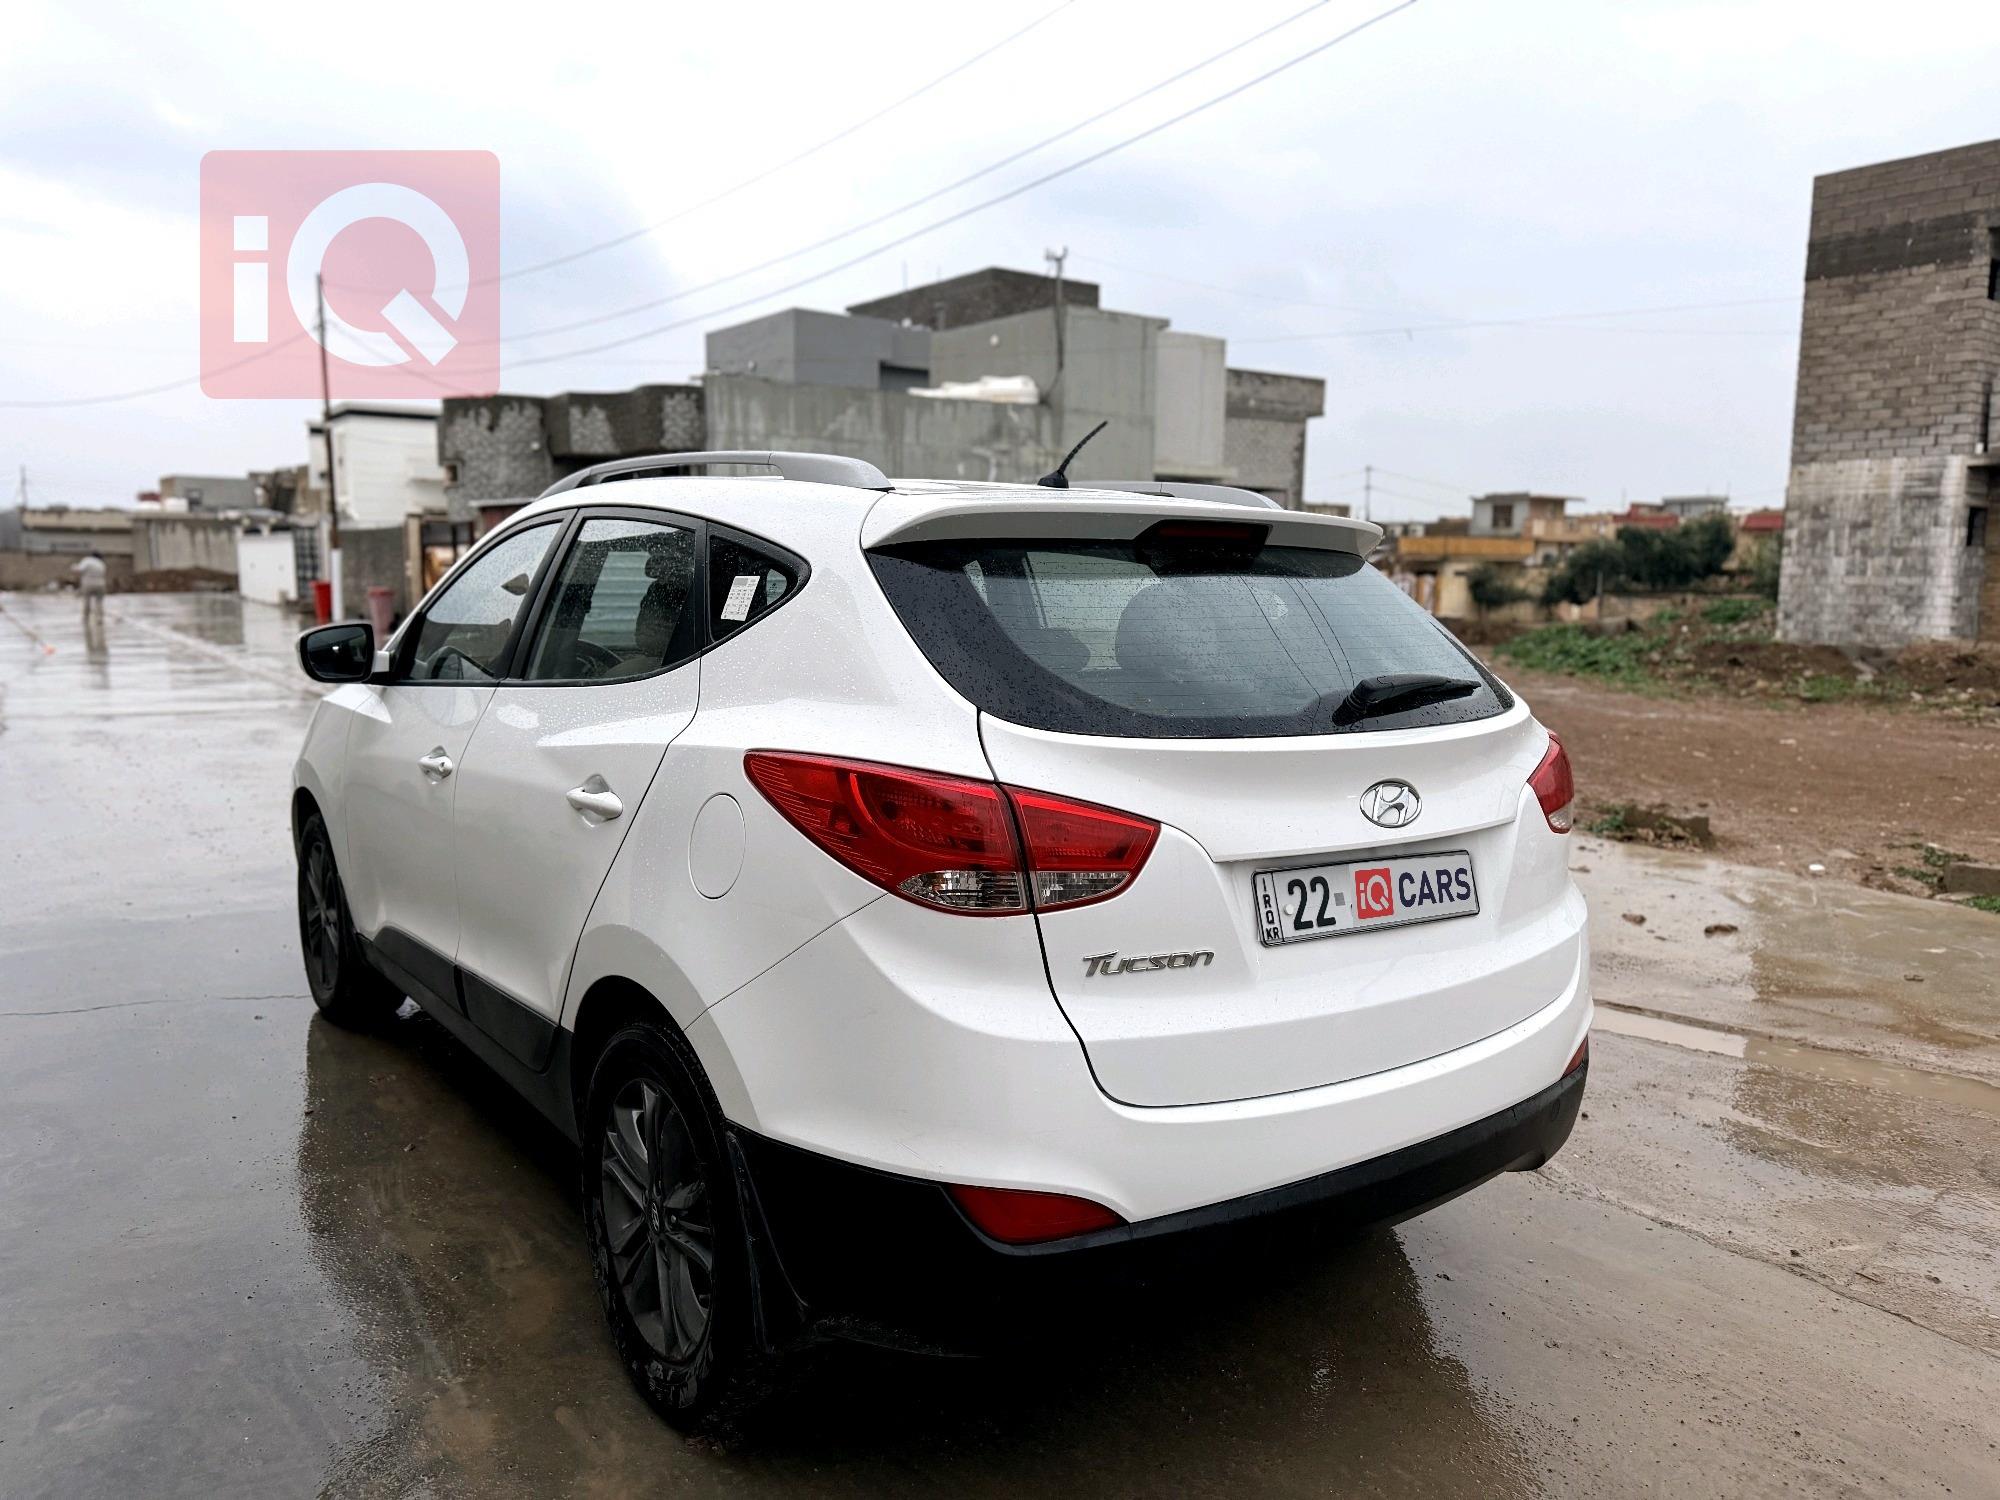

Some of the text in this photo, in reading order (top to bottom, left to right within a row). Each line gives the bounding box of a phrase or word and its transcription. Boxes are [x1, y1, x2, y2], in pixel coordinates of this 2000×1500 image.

[1287, 875, 1336, 930] 22
[1266, 927, 1280, 940] KR
[1083, 949, 1215, 978] Tucson
